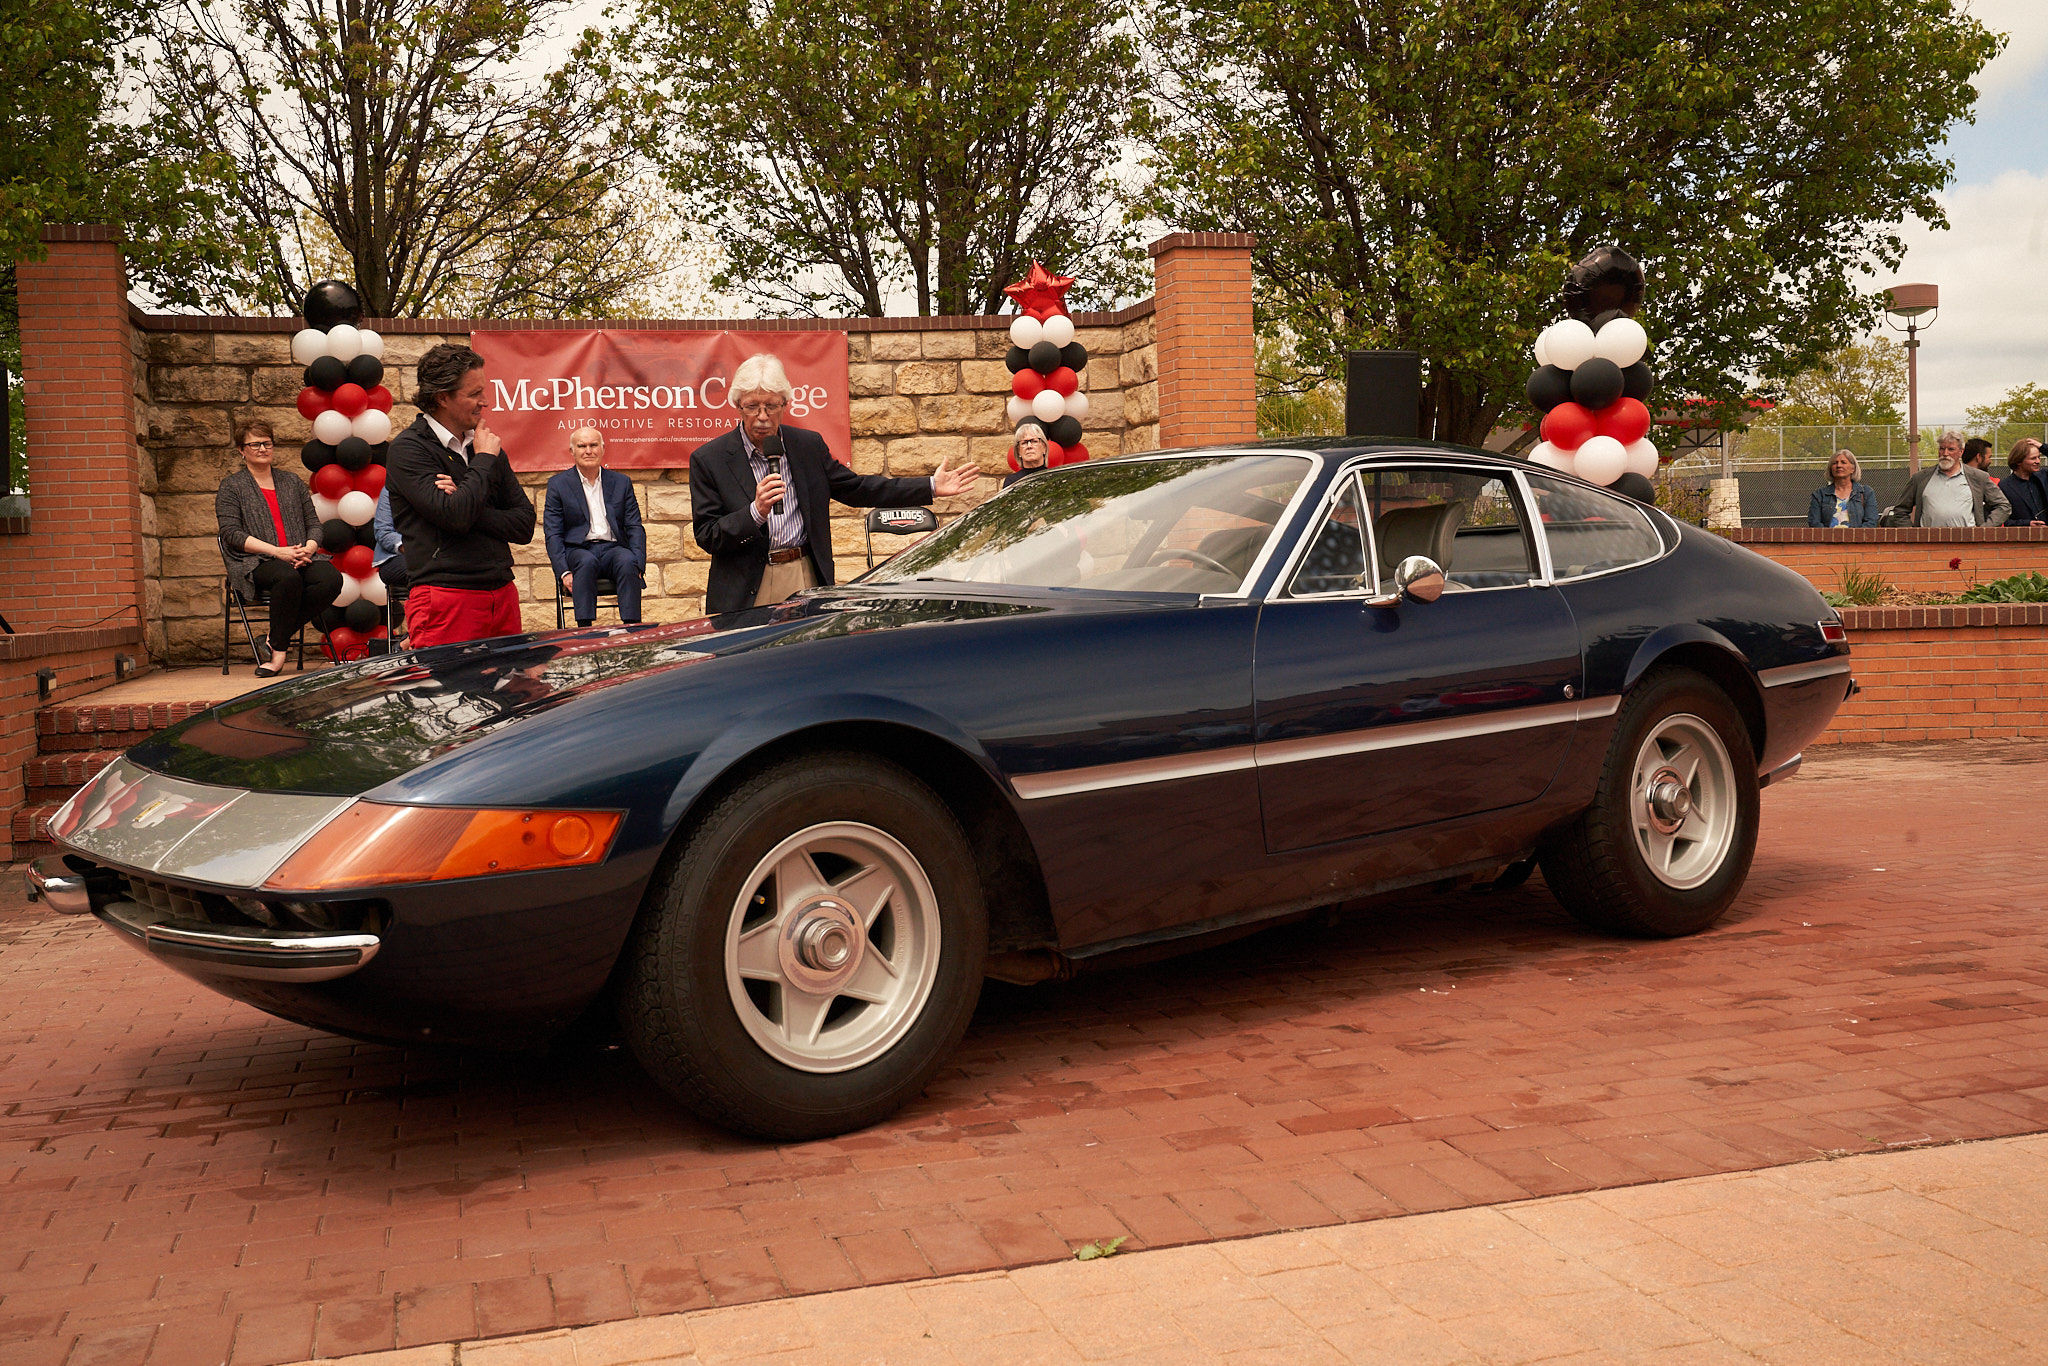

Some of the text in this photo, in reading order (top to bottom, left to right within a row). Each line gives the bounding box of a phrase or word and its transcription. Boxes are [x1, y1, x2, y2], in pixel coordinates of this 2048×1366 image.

[489, 376, 697, 411] McPherson
[557, 418, 741, 430] AUTOMOTIVE RESTORAT
[609, 435, 716, 444] www.mcpherson.edu/autorestoratio
[881, 510, 924, 523] BULLDOGS
